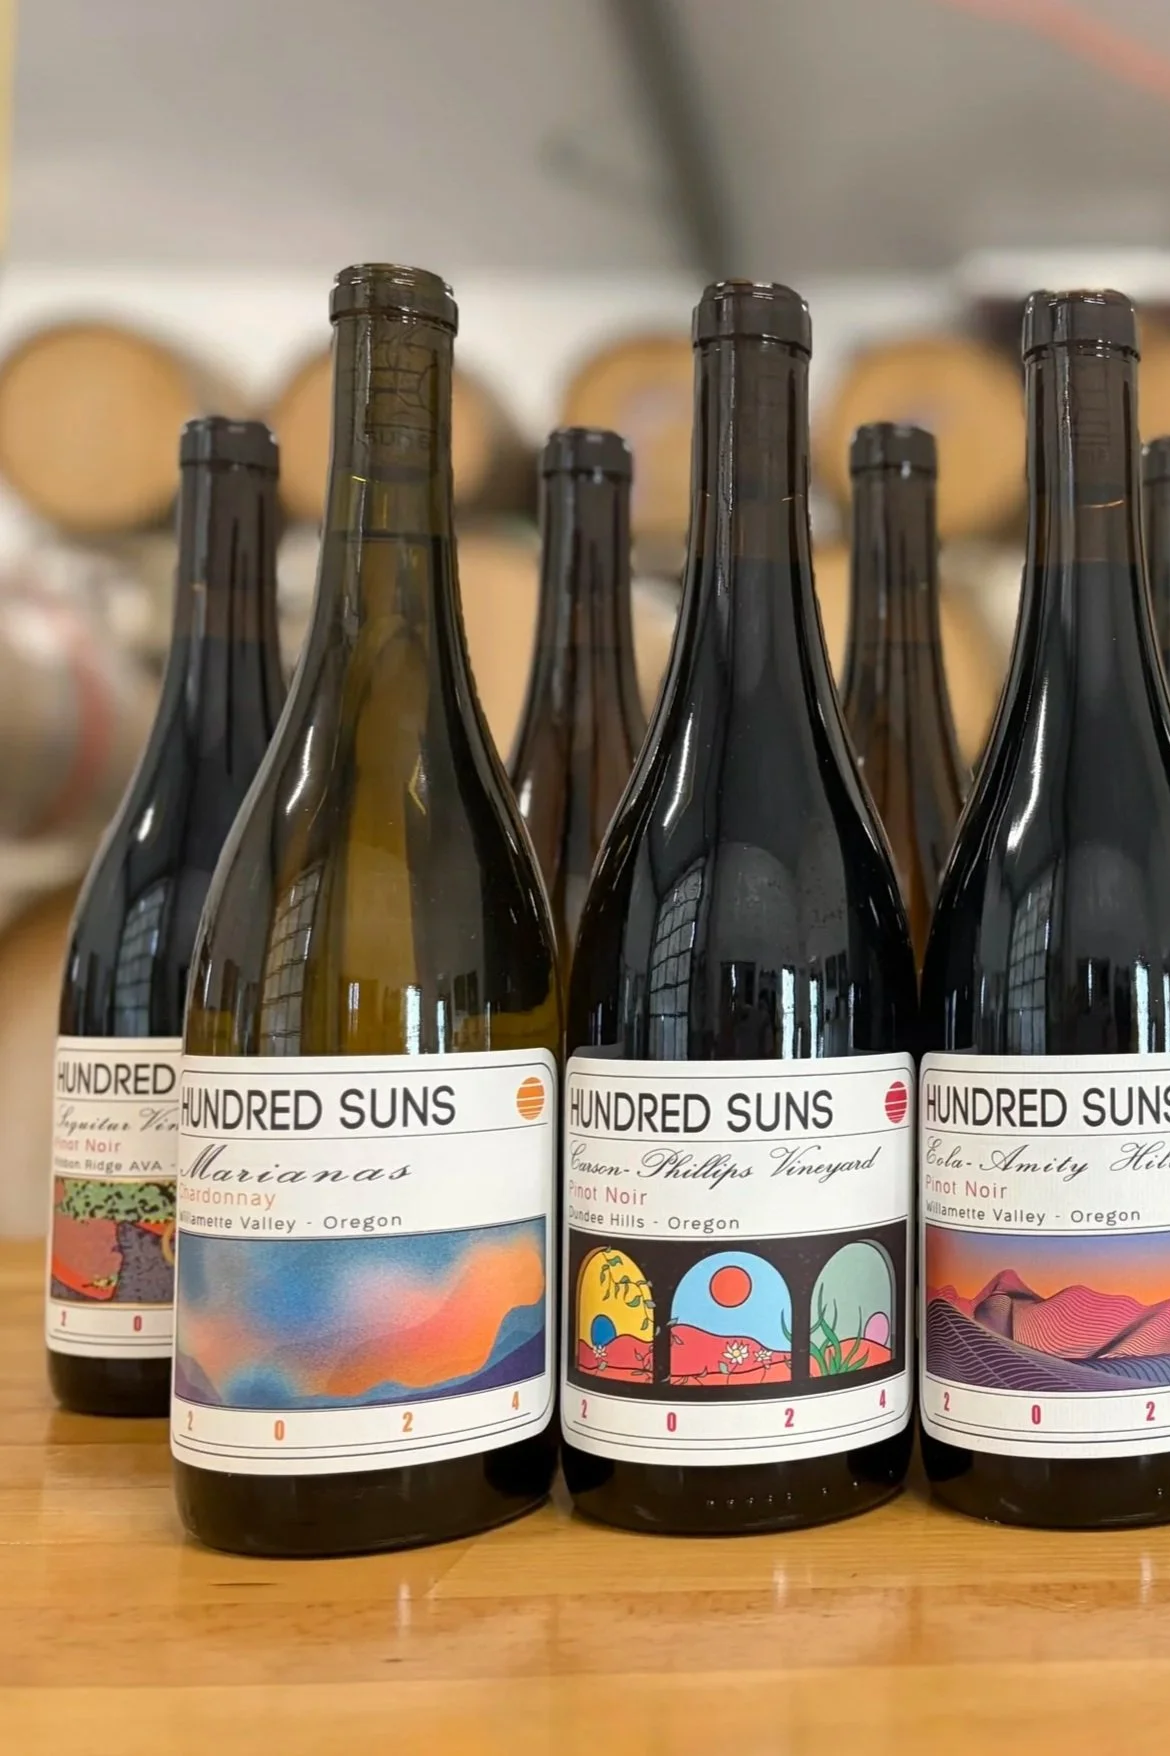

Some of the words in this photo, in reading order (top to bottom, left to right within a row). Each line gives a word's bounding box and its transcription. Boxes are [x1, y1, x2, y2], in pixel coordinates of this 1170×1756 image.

[58, 1061, 176, 1095] HUNDRED
[57, 1103, 131, 1135] Sequitur
[139, 1107, 180, 1132] Vin
[181, 1085, 322, 1131] HUNDRED
[339, 1085, 456, 1130] SUNS
[570, 1087, 711, 1134] HUNDRED
[727, 1089, 833, 1133] SUNS
[927, 1083, 1067, 1128] HUNDRED
[55, 1137, 80, 1151] not
[85, 1138, 121, 1153] Noir
[85, 1159, 123, 1174] Ridge
[129, 1160, 163, 1171] AVA
[180, 1143, 413, 1183] Marianas
[770, 1145, 882, 1184] Vineyard
[569, 1179, 597, 1201] Pinot
[605, 1186, 648, 1205] Noir
[925, 1174, 957, 1196] Pinot
[965, 1180, 1008, 1200] Noir
[240, 1216, 296, 1234] Valley
[323, 1215, 402, 1232] Oregon
[569, 1205, 605, 1225] Dundee
[610, 1212, 645, 1229] Hills
[668, 1216, 739, 1234] Oregon
[925, 1200, 985, 1222] Willamette
[993, 1209, 1046, 1226] Valley
[1070, 1209, 1141, 1227] Oregon
